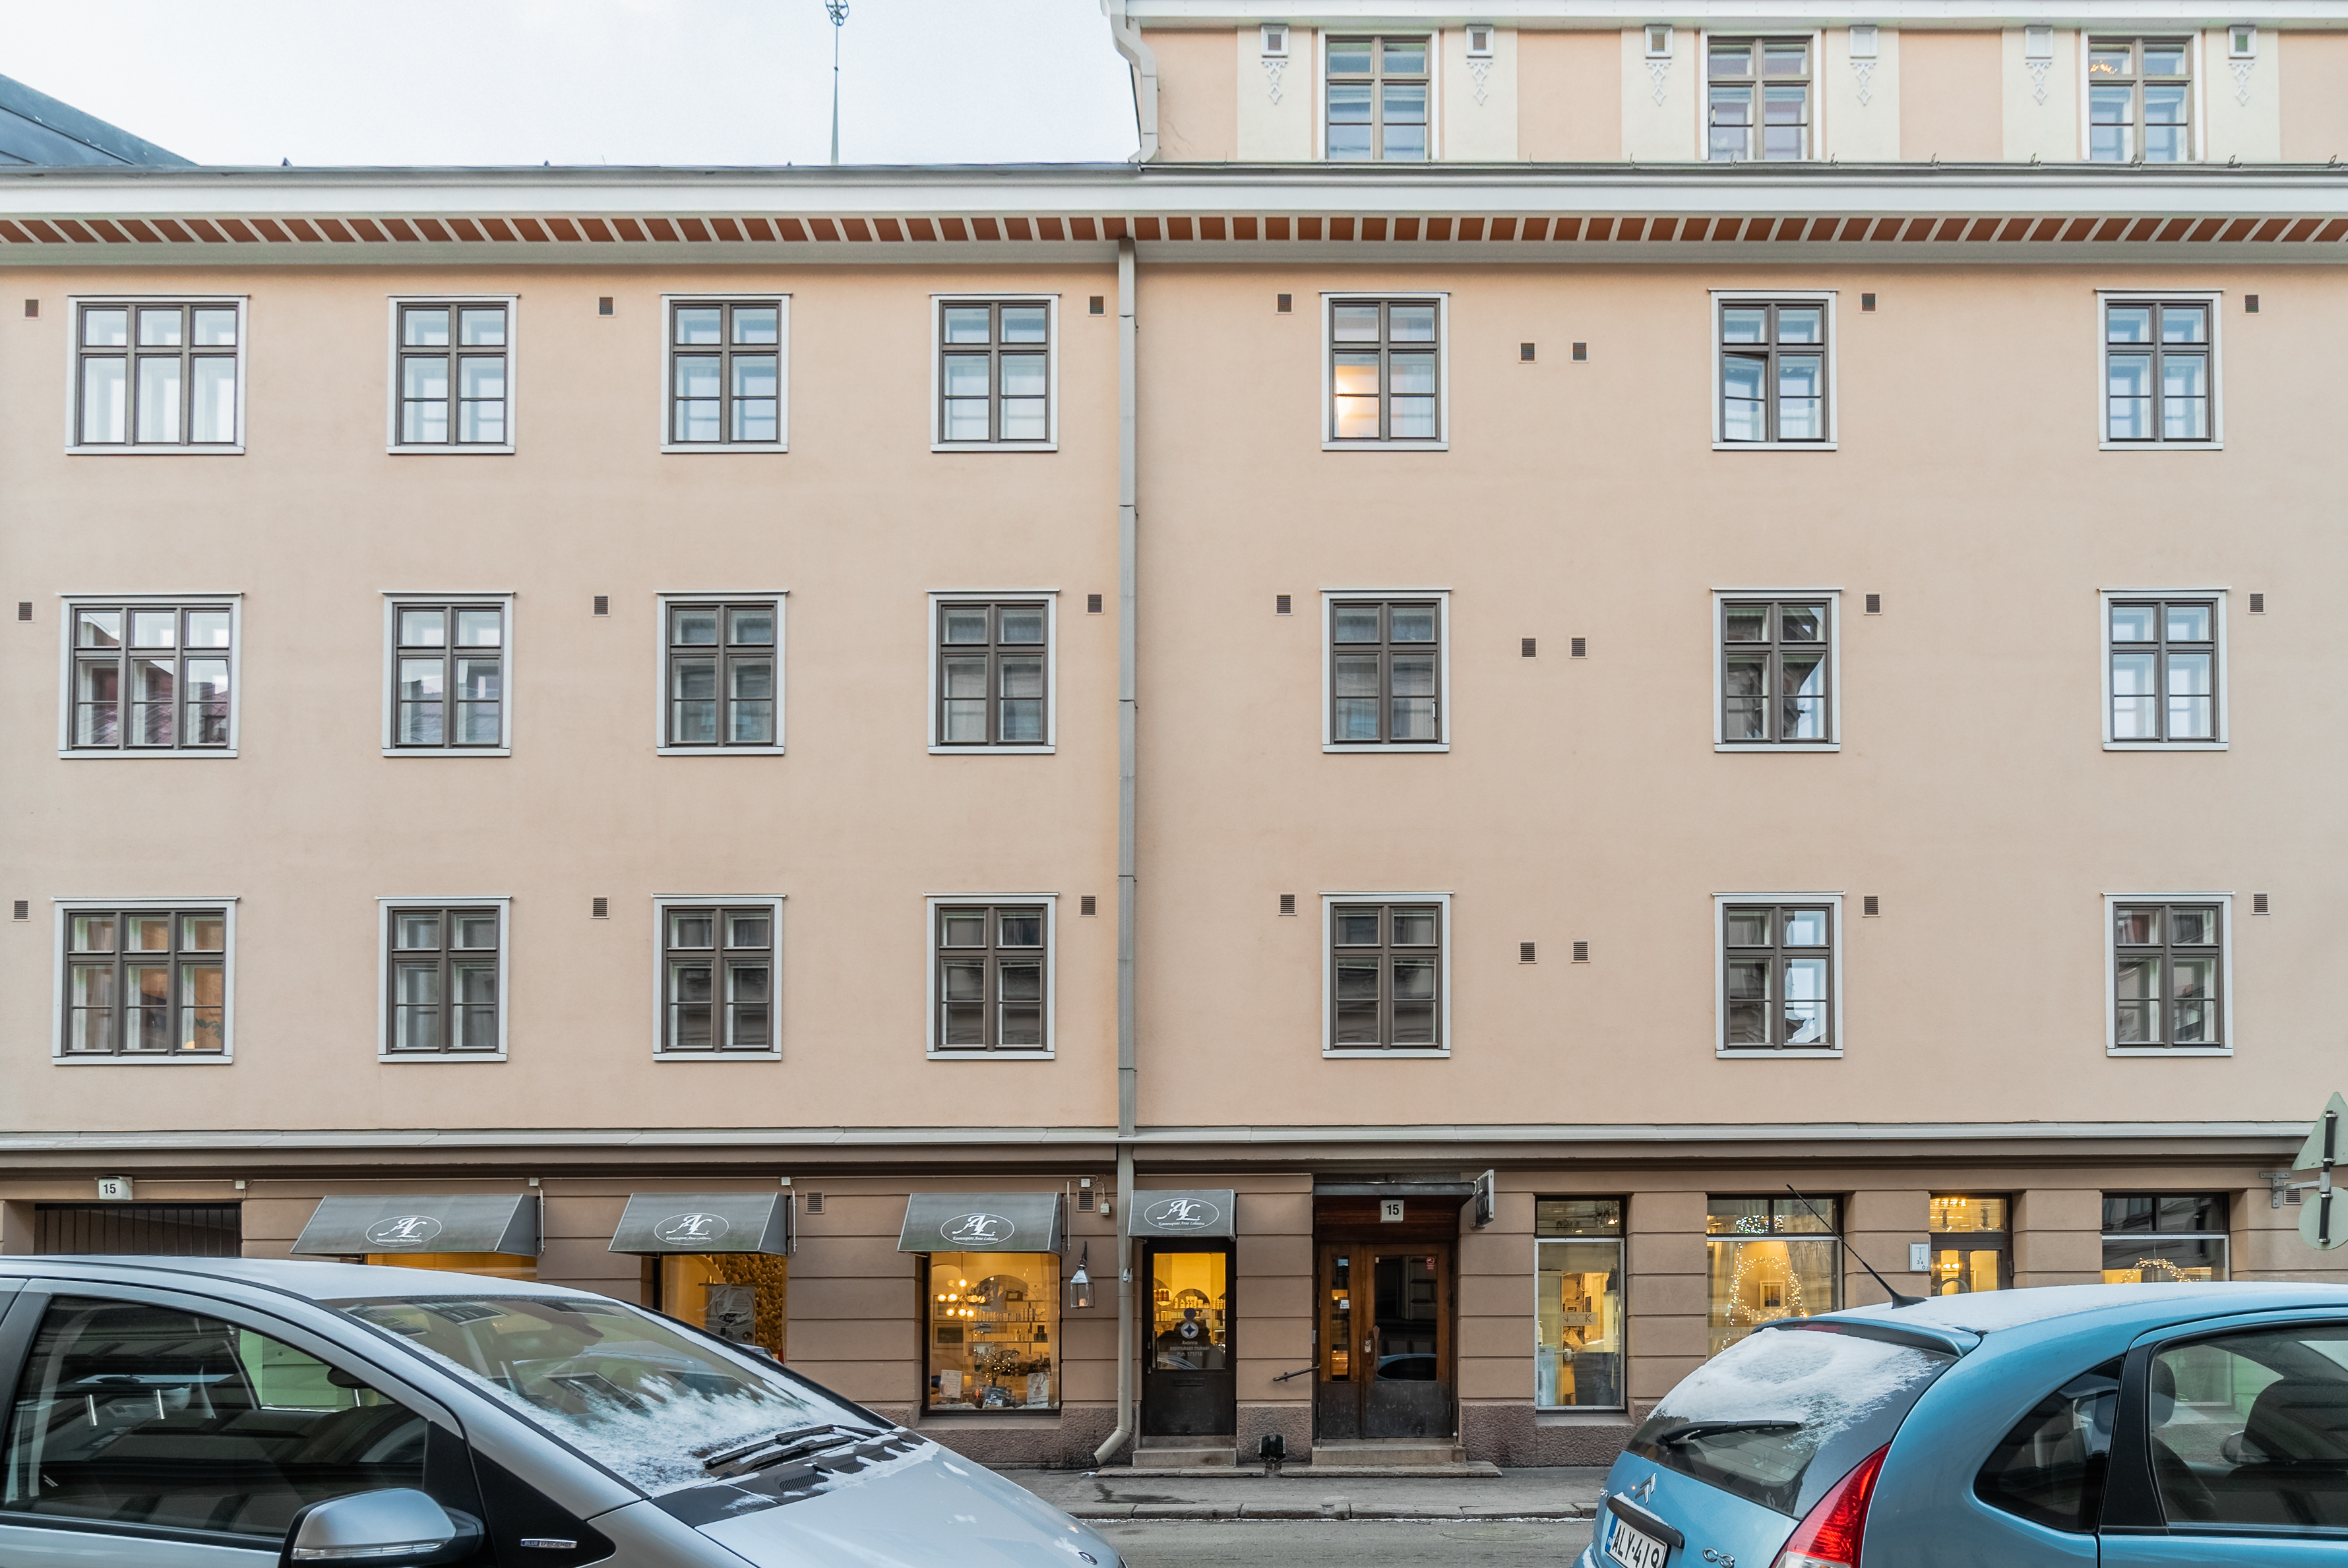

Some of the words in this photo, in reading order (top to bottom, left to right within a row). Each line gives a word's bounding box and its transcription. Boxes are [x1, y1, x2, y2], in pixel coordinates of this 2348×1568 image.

[103, 1183, 117, 1194] 15
[1386, 1204, 1400, 1216] 15
[1702, 1547, 1736, 1568] C3
